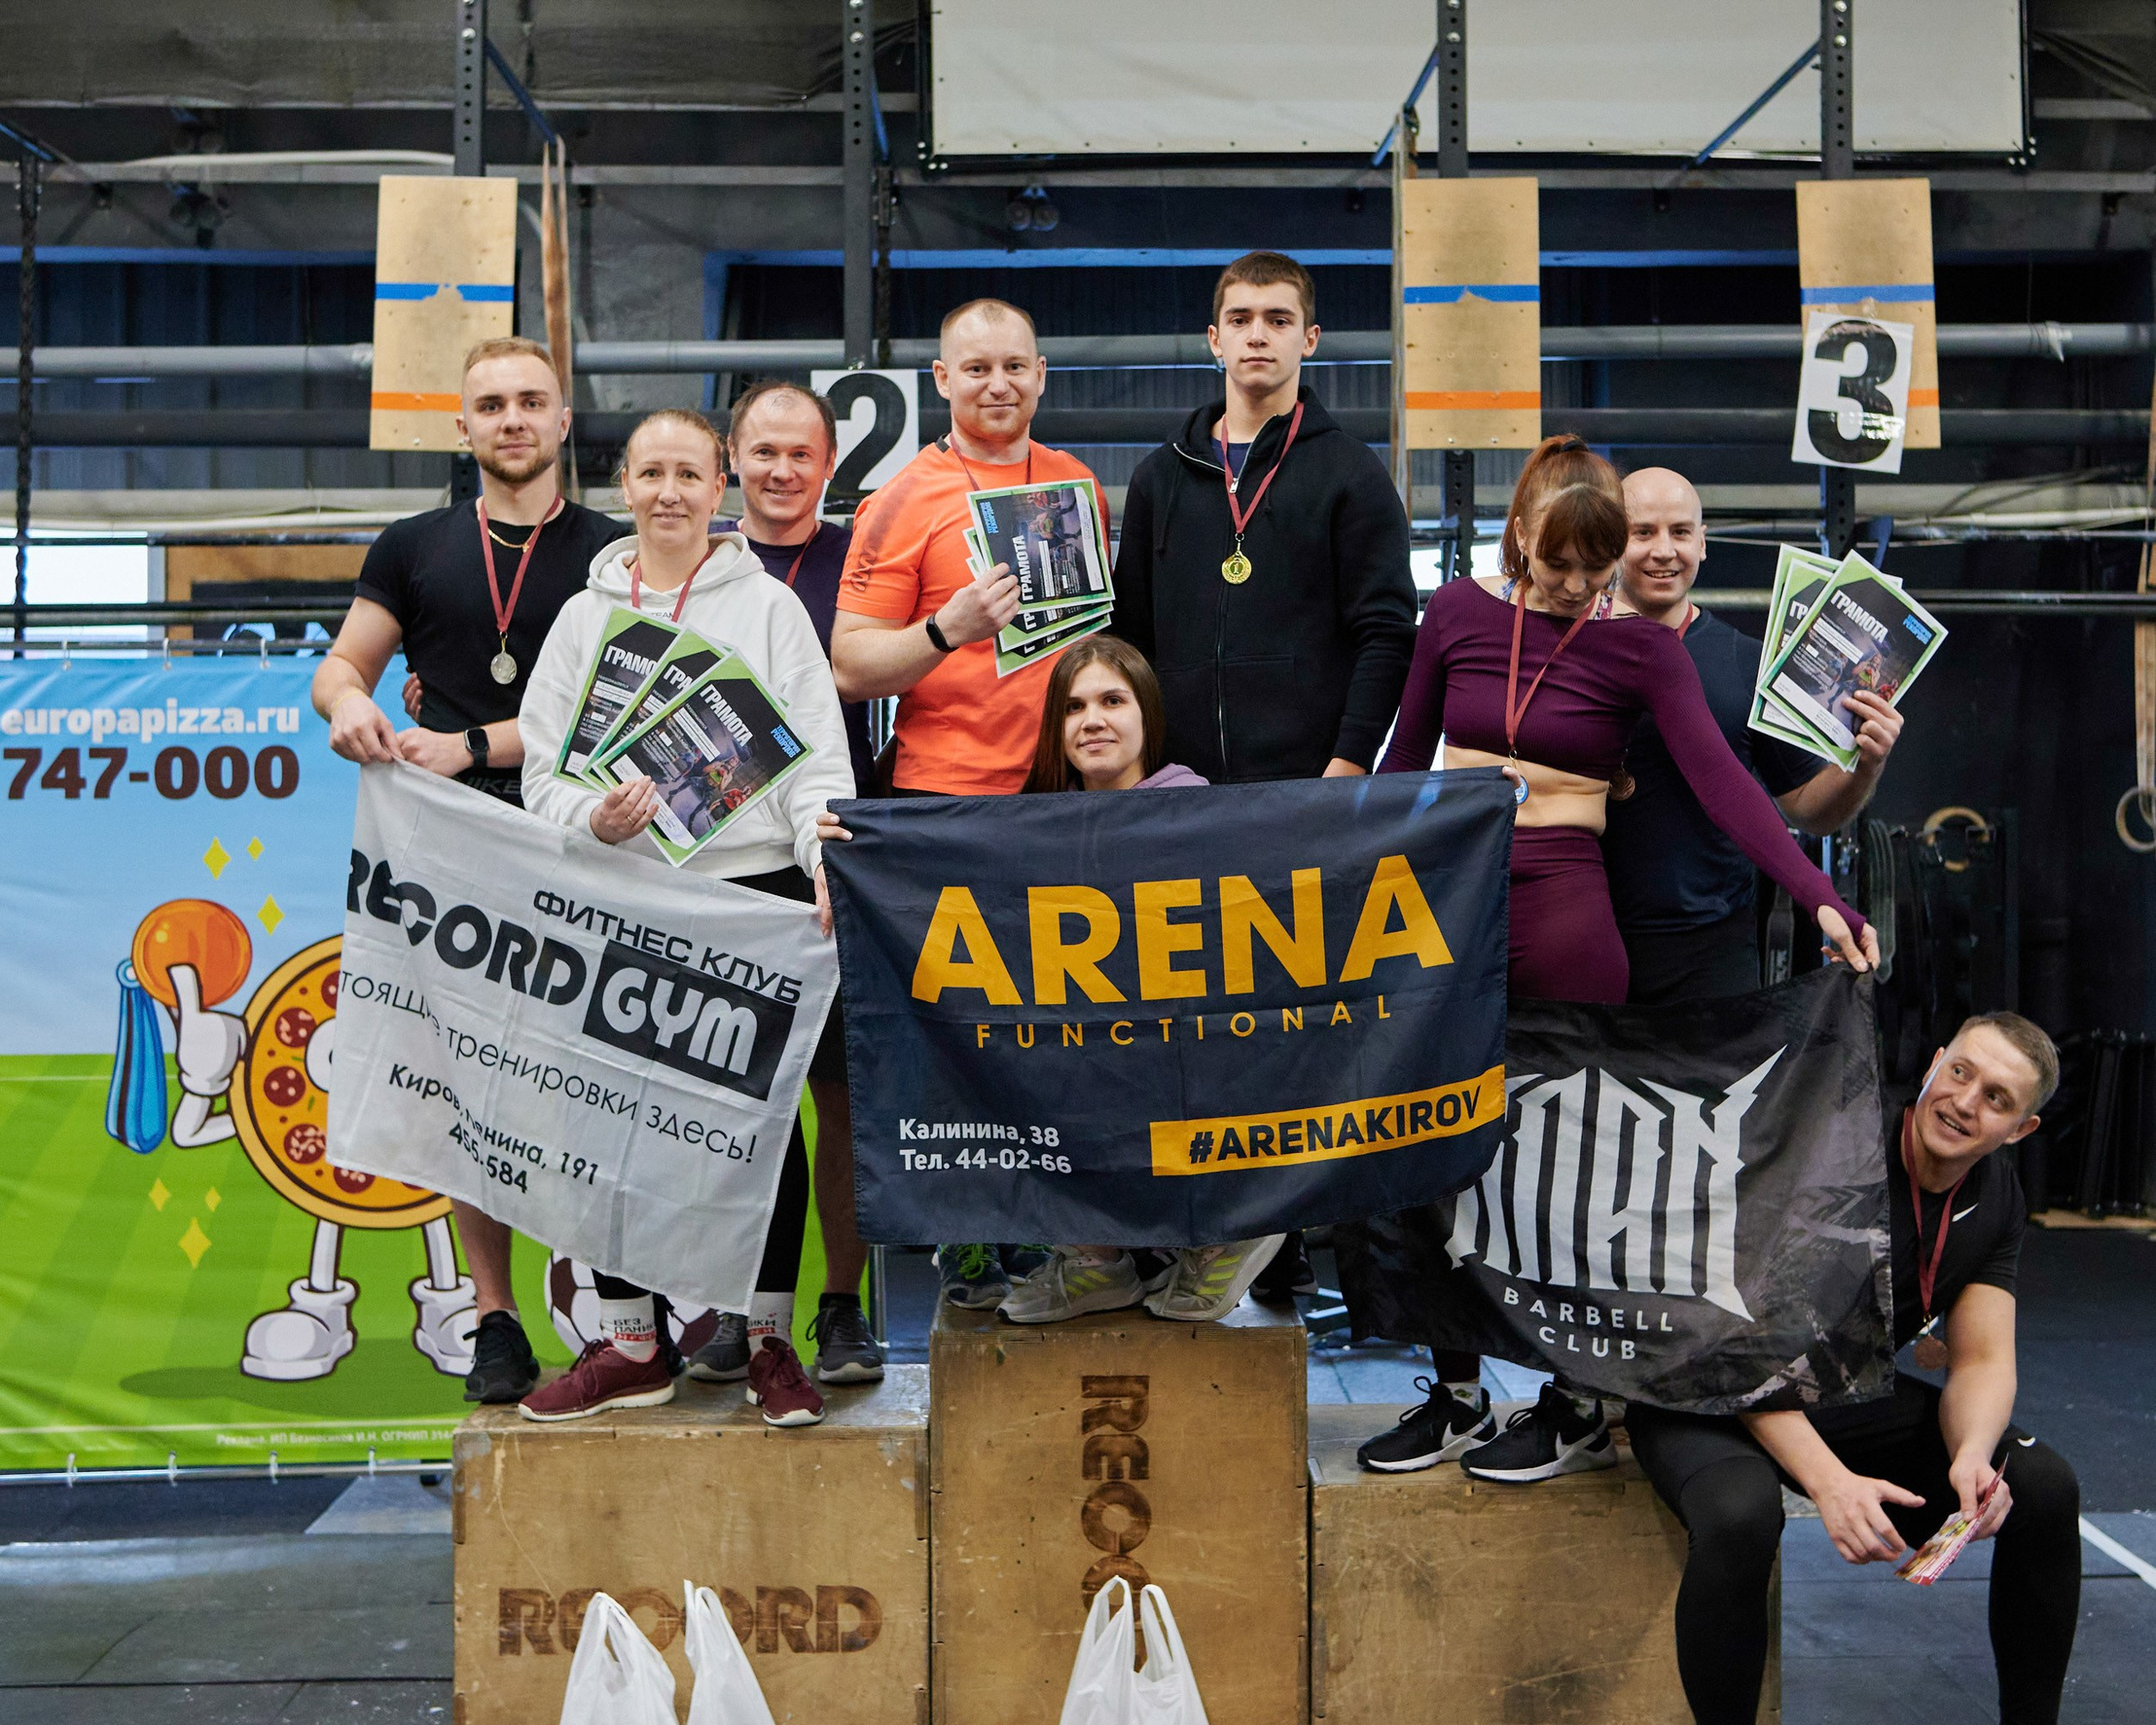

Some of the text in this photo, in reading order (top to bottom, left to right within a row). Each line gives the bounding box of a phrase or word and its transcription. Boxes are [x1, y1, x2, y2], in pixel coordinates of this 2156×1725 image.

[1808, 320, 1896, 463] 3
[823, 373, 906, 515] 2
[1012, 535, 1034, 601] ГРАМОТА
[1830, 589, 1889, 644] ГРАМОТА
[1, 698, 300, 743] europapizza.ru
[699, 683, 754, 748] ГРАМОТА
[3, 745, 300, 800] 747-000
[533, 889, 803, 1005] ФИТНЕС КЛУБ
[910, 853, 1455, 1007] ARENA
[976, 994, 1391, 1049] FUNCTIONAL
[447, 1026, 639, 1121] тренировки
[645, 1104, 757, 1164] здесь!
[899, 1118, 1061, 1148] Калинина, 38
[1188, 1084, 1482, 1164] #ARENAKIROV
[561, 1151, 599, 1185] 191
[899, 1147, 1073, 1175] Тел. 44-02-66
[1503, 1286, 1674, 1333] BARBELL
[1539, 1325, 1637, 1360] CLUB
